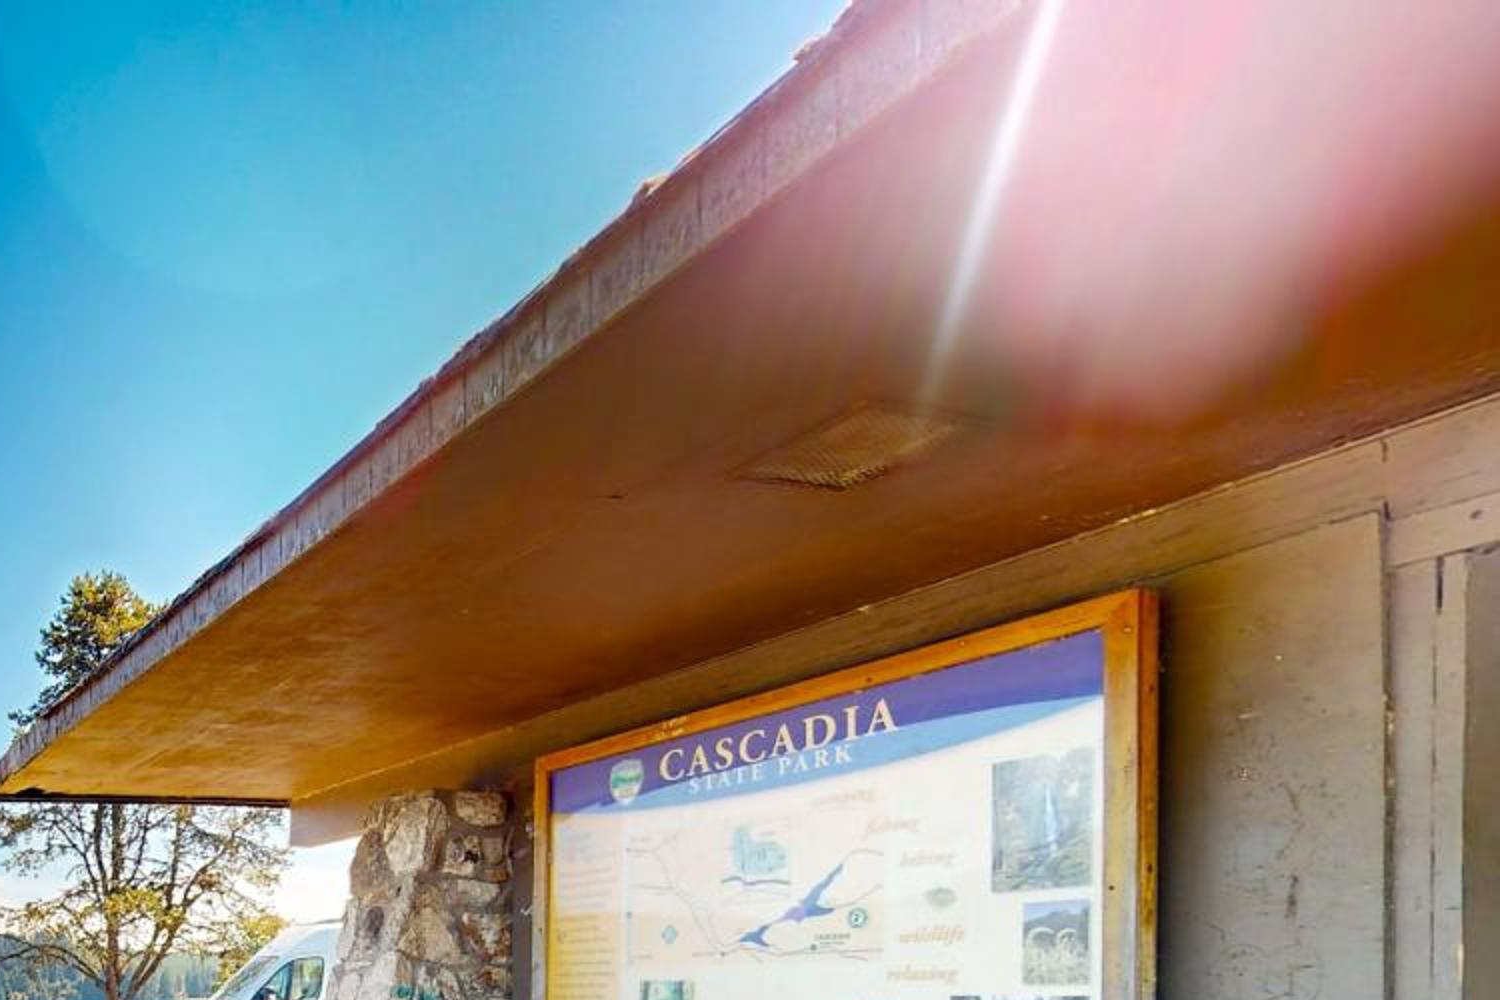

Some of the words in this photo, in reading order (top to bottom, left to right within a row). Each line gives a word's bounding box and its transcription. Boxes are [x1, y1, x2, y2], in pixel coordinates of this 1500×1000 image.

[659, 697, 899, 782] CASCADIA
[689, 762, 768, 795] STATE
[779, 745, 852, 776] PARK
